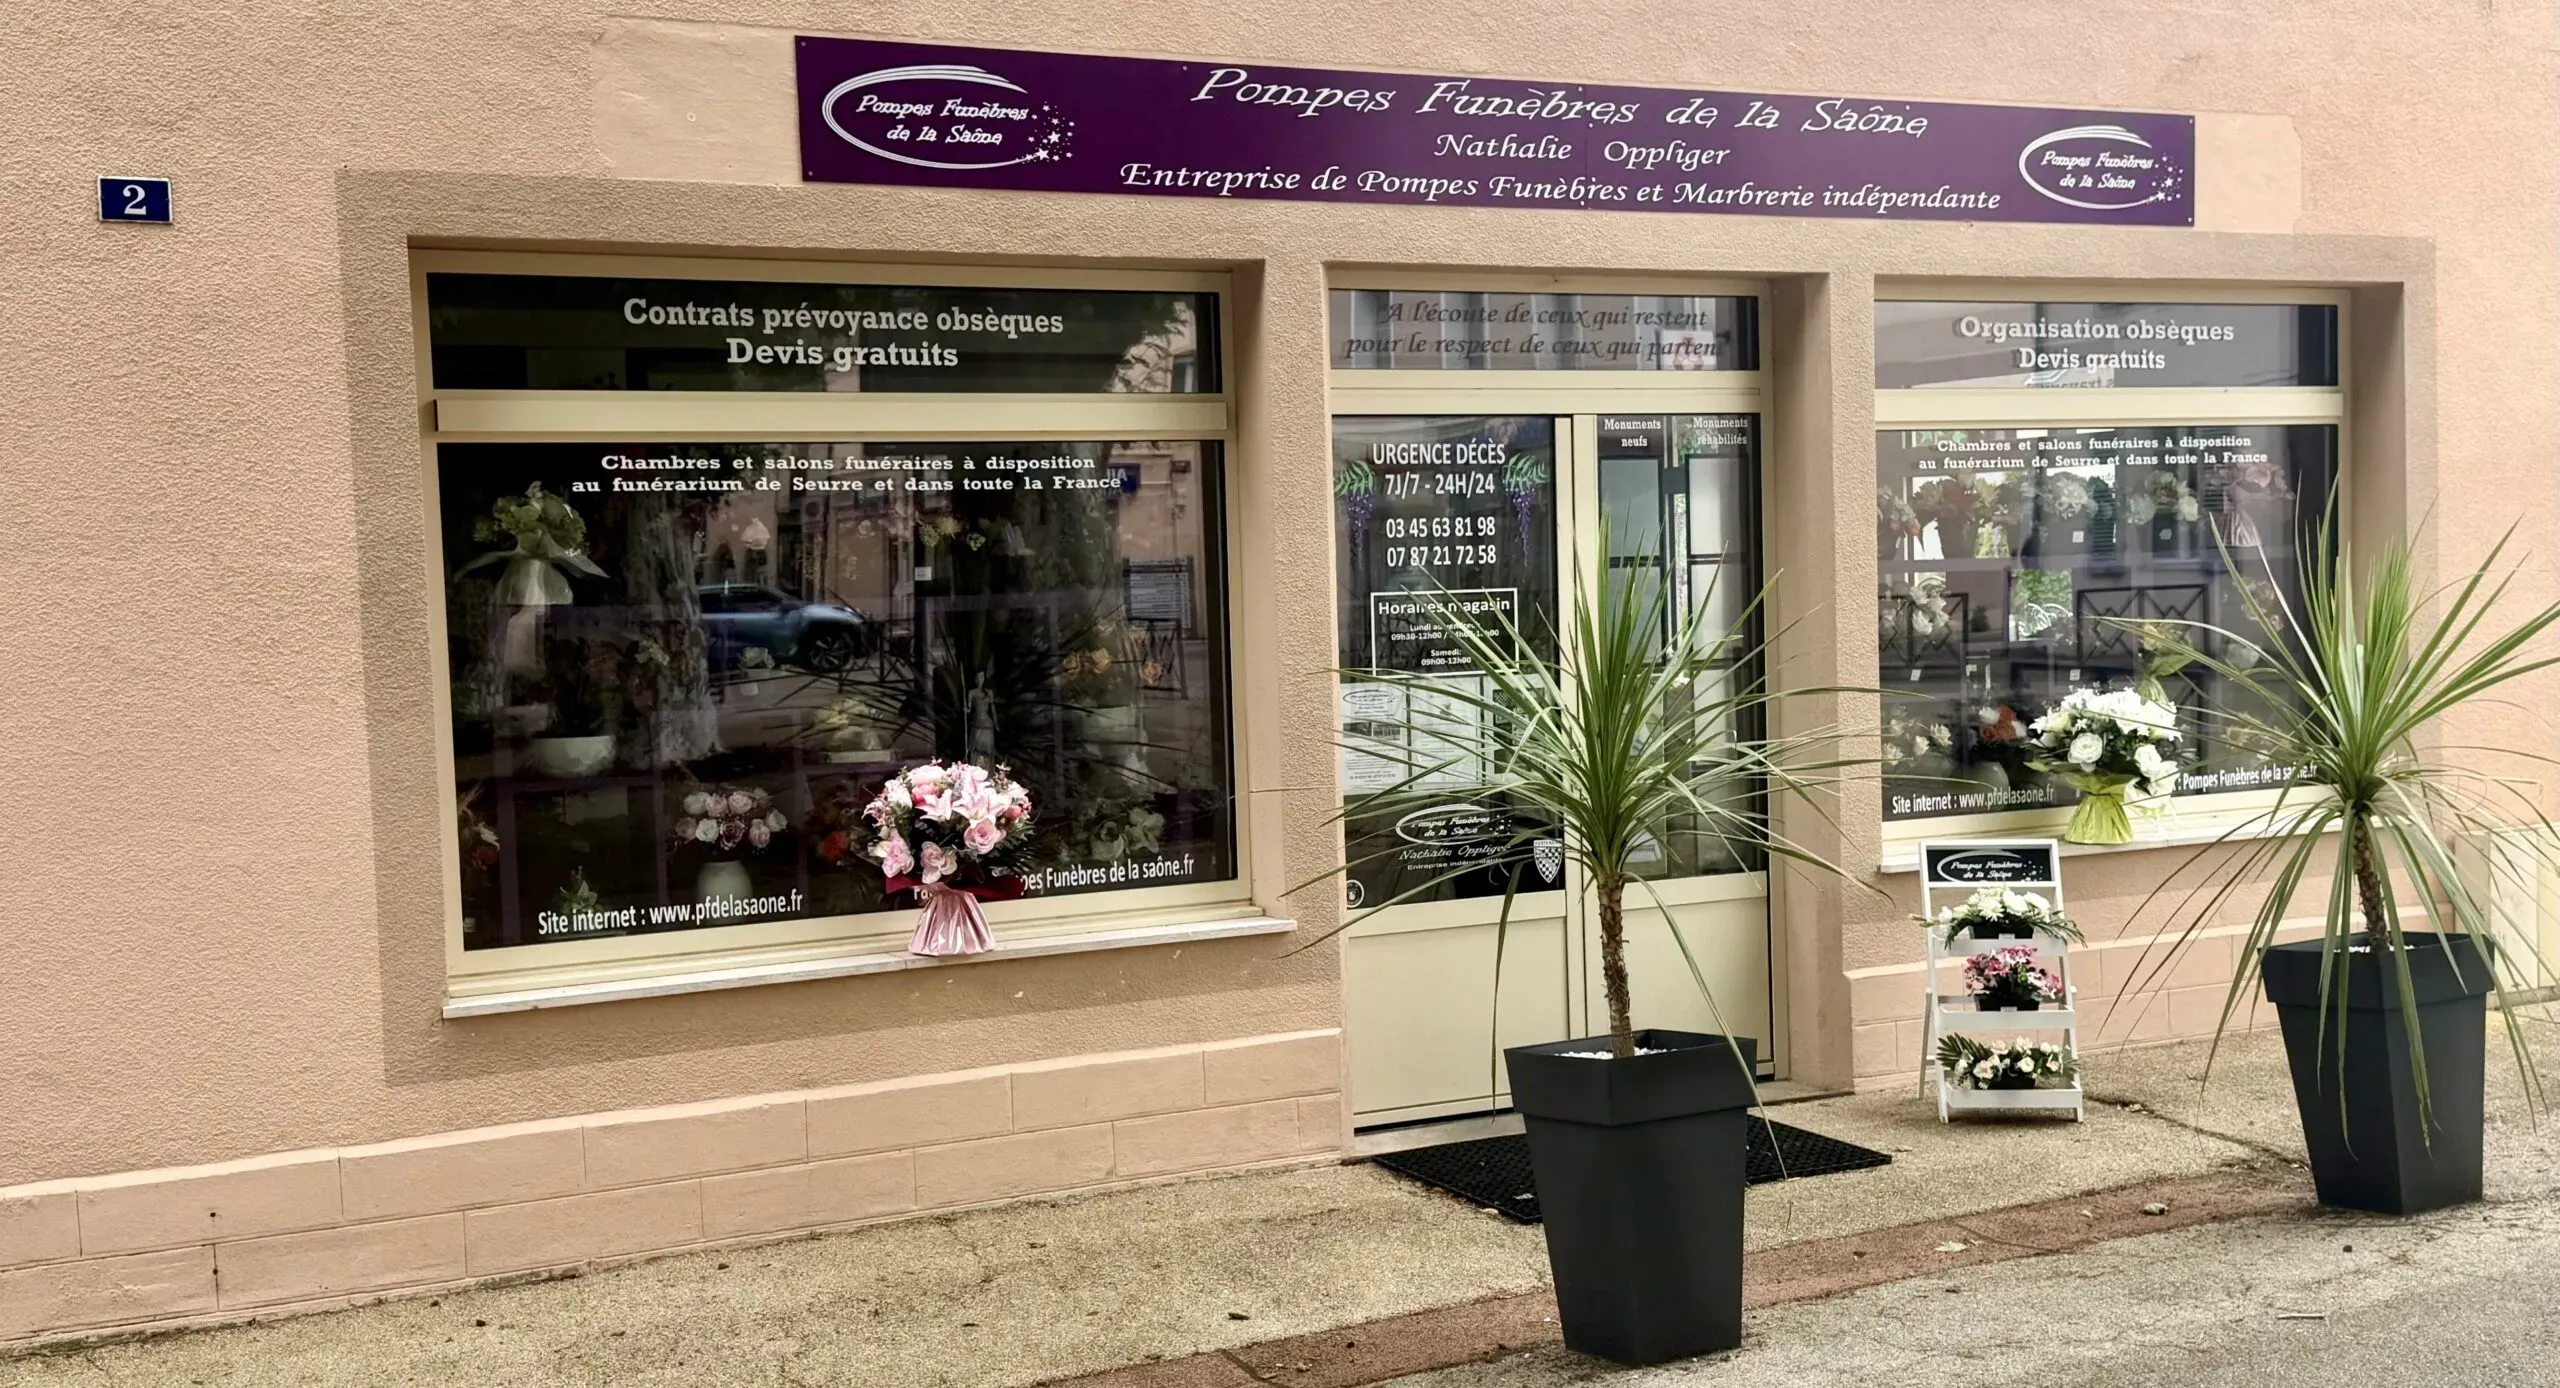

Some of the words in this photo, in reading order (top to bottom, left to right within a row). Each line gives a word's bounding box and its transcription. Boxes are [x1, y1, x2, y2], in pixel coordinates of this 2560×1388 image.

[856, 95, 934, 119] Pompes
[940, 98, 1029, 121] Funèbres
[1190, 67, 1395, 118] Pompes
[1415, 80, 1640, 128] Funèbres
[1665, 97, 1718, 128] de
[1736, 101, 1782, 131] la
[1800, 98, 1930, 137] Saône
[886, 124, 911, 142] de
[916, 126, 938, 142] la
[945, 124, 1003, 145] Saône
[1434, 133, 1573, 161] Nathalie
[1602, 138, 1731, 169] Oppliger
[2040, 150, 2092, 170] Pompes
[2095, 152, 2154, 170] Funèbres
[1120, 161, 1303, 197] Entreprise
[1310, 165, 1348, 193] de
[1357, 168, 1480, 203] Pompes
[1488, 175, 1628, 205] Funèbres
[1636, 181, 1664, 203] et
[1673, 181, 1815, 210] Marbrerie
[1821, 184, 2001, 214] indépendante
[2059, 174, 2076, 188] de
[2079, 175, 2093, 188] la
[2097, 173, 2136, 189] Saône
[122, 184, 147, 216] 2
[622, 297, 755, 331] Contrats
[763, 301, 929, 337] prévoyance
[936, 303, 1065, 338] obsèques
[1412, 300, 1499, 324] l'écoute
[1504, 301, 1532, 324] de
[1536, 310, 1590, 329] ceux
[1592, 306, 1630, 331] qui
[1634, 308, 1708, 326] restent
[1958, 315, 2121, 344] Organisation
[2125, 316, 2235, 346] obsèques
[725, 336, 824, 368] Devis
[832, 339, 959, 374] gratuits
[1345, 338, 1403, 360] pour
[1407, 332, 1428, 354] le
[1434, 336, 1511, 360] respect
[1519, 333, 1546, 355] de
[1551, 340, 1605, 358] ceux
[1607, 336, 1643, 361] qui
[2018, 347, 2080, 370] Devis
[2084, 349, 2166, 373] gratuits
[1603, 418, 1662, 431] Monuments
[1692, 416, 1749, 429] Monuments
[1372, 442, 1452, 466] URGENCE
[1456, 437, 1506, 466] DÉCÈS
[1620, 434, 1648, 448] neufs
[1937, 438, 2011, 453] Chambres
[2018, 439, 2031, 452] et
[2037, 437, 2083, 452] salons
[2088, 436, 2160, 451] funéraires
[2165, 435, 2174, 449] à
[2179, 434, 2252, 452] disposition
[601, 454, 721, 471] Chambres
[732, 456, 754, 471] et
[764, 454, 835, 471] salons
[845, 454, 954, 472] funéraires
[962, 455, 977, 471] à
[985, 454, 1096, 473] disposition
[1918, 458, 1937, 470] au
[1943, 455, 2025, 470] funérarium
[2031, 454, 2049, 469] de
[2054, 454, 2101, 468] Seurre
[2106, 455, 2120, 466] et
[2126, 452, 2159, 467] dans
[2163, 453, 2198, 466] toute
[2203, 451, 2217, 465] la
[2222, 450, 2268, 464] France
[571, 479, 601, 494] au
[612, 476, 745, 493] funérarium
[755, 476, 783, 493] de
[792, 476, 864, 493] Seurre
[874, 476, 895, 492] et
[904, 474, 954, 492] dans
[962, 475, 1014, 491] toute
[1024, 474, 1044, 491] la
[1053, 474, 1122, 491] France
[1385, 471, 1420, 500] 7J/7
[1435, 470, 1496, 499] 24H/24
[1385, 517, 1405, 539] 03
[1409, 517, 1428, 538] 45
[1432, 517, 1451, 538] 63
[1454, 516, 1473, 537] 81
[1477, 515, 1497, 537] 98
[1386, 547, 1406, 568] 07
[1410, 546, 1429, 567] 87
[1433, 545, 1452, 566] 21
[1455, 544, 1475, 566] 72
[1478, 544, 1497, 565] 58
[1410, 623, 1432, 632] Lundi
[2182, 772, 2219, 793] Pompes
[2219, 767, 2260, 787] Funèbres
[2260, 765, 2272, 784] de
[2273, 762, 2281, 781] la
[1892, 795, 1912, 815] Site
[1912, 793, 1952, 813] internet
[1021, 871, 1043, 896] pes
[1046, 863, 1106, 889] Funèbres
[1109, 861, 1126, 882] de
[1128, 859, 1139, 880] la
[1142, 853, 1195, 879] saône.fr
[537, 910, 569, 936] Site
[572, 904, 637, 933] internet
[648, 888, 804, 926] www.pfdelasaone.fr
